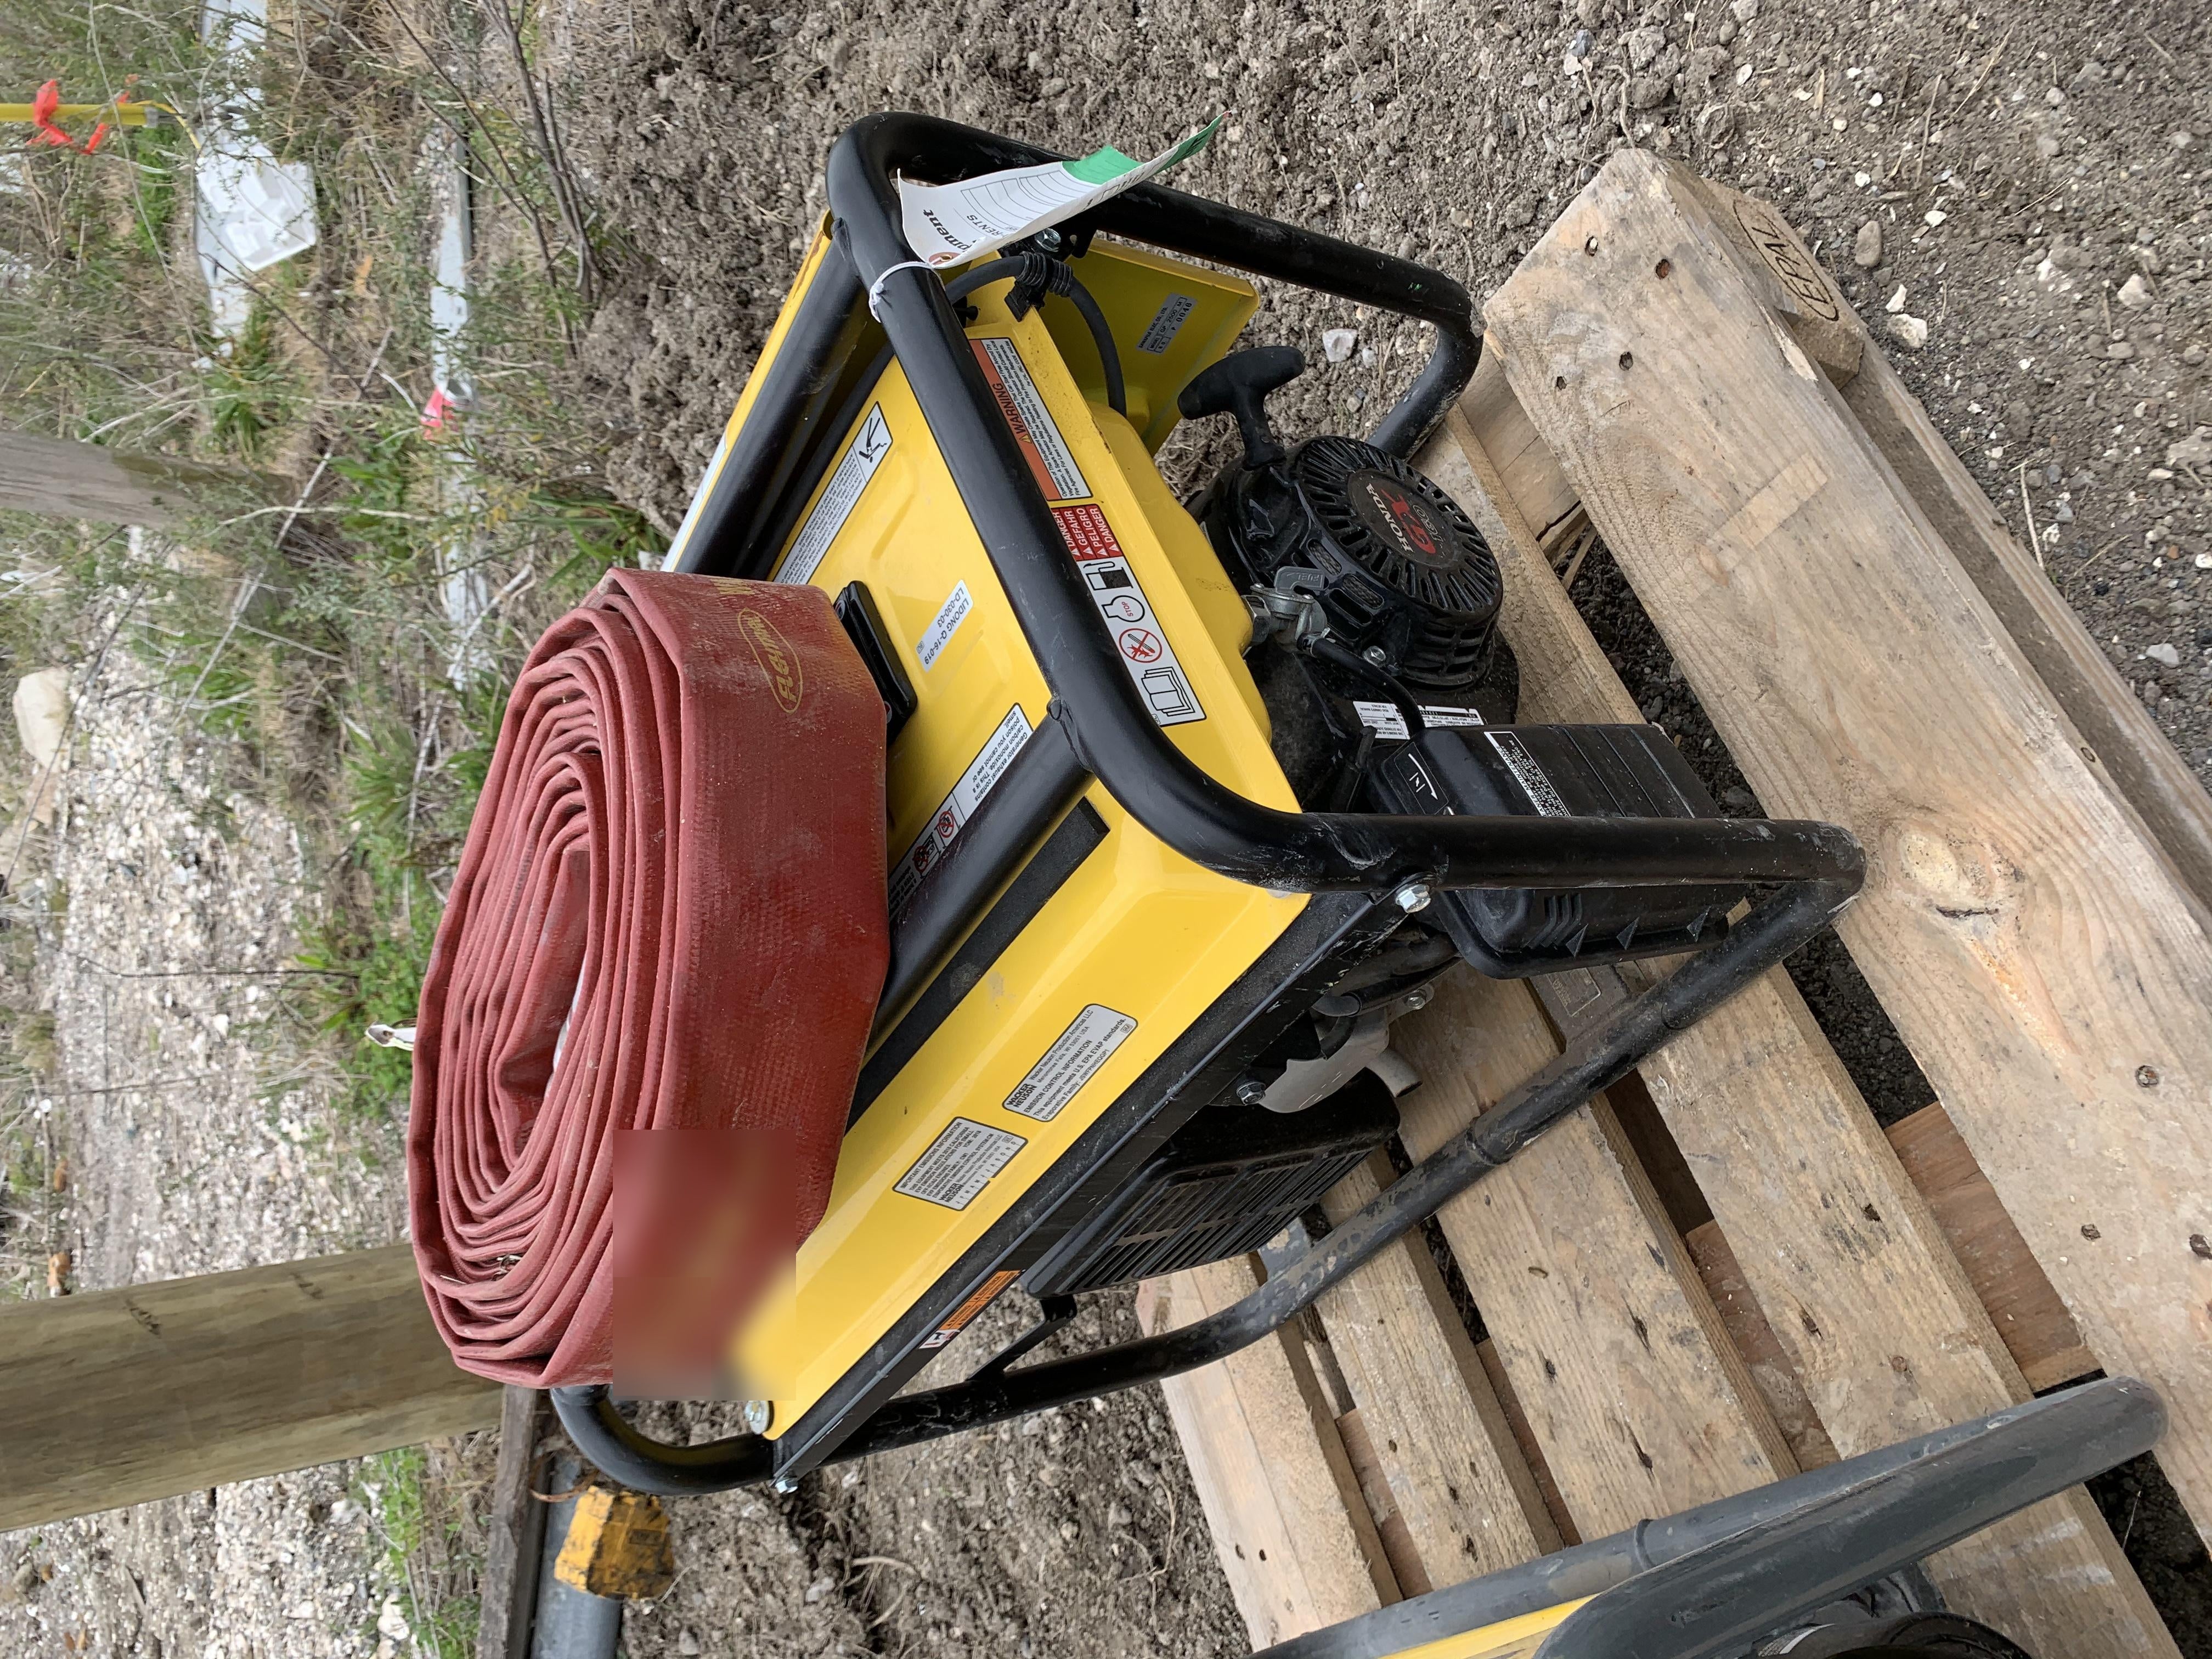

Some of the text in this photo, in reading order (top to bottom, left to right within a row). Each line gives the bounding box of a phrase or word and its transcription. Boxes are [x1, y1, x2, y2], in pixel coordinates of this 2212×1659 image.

[967, 215, 1006, 238] -RENTS
[1752, 223, 1829, 304] EPAL
[990, 341, 998, 350] Local
[988, 351, 999, 364] Around
[995, 351, 1006, 365] Contact
[996, 365, 1004, 374] Fires
[1001, 375, 1009, 383] Start
[1003, 366, 1014, 379] Should
[1010, 380, 1023, 396] Operator
[1012, 370, 1026, 390] Prevention
[991, 382, 1026, 433] WARNING
[1015, 402, 1026, 415] Sparks
[1029, 403, 1042, 419] Relating
[1022, 416, 1033, 429] Create
[1038, 420, 1054, 443] Regulations
[1030, 430, 1039, 438] May
[1036, 430, 1045, 439] May
[1034, 439, 1049, 461] Equipment
[1041, 439, 1053, 455] Arrestor
[1053, 449, 1062, 459] Laws
[1049, 456, 1060, 468] Spark
[1053, 476, 1068, 496] Operation
[1059, 473, 1074, 496] Vegetation.
[1063, 468, 1077, 487] Agencies
[1075, 507, 1103, 546] PELIGRO
[1089, 508, 1114, 542] DANGER
[1366, 483, 1413, 552] HONDA
[1051, 512, 1076, 546] DANGER
[1063, 510, 1088, 545] GEFAHR
[1296, 572, 1319, 581] FUEL
[936, 587, 964, 628] LD-030-03
[1121, 601, 1133, 617] STOP
[923, 597, 969, 665] LIDONG Q-16-019
[1003, 710, 1017, 729] smell.
[1005, 716, 1020, 738] poison
[996, 735, 1006, 748] you
[1008, 724, 1024, 745] carbon
[984, 746, 998, 768] cannot
[988, 742, 1009, 772] monoxide.
[1511, 749, 1529, 769] SOLVENT
[1522, 759, 1536, 772] CLEAN
[974, 731, 1028, 803] Generator exhaust contains
[1495, 746, 1530, 790] MAINTENANCE
[1514, 763, 1527, 778] HOURS
[972, 774, 977, 783] or
[975, 781, 980, 789] is
[979, 770, 989, 785] This
[1533, 785, 1546, 800] DUSTY
[1547, 788, 1556, 797] OUT
[1547, 794, 1558, 806] THEN
[1544, 803, 1556, 815] NDER
[1006, 1082, 1030, 1106] WACKER
[1052, 1034, 1073, 1054] Production
[1068, 1018, 1087, 1036] Americas
[1082, 1009, 1094, 1019] LLC
[1013, 1084, 1037, 1108] NEUSON
[1079, 1025, 1090, 1035] USA
[1033, 1017, 1126, 1116] This equipment meets U.S. EPA EVAP standards.
[1024, 1039, 1093, 1113] EMISSION CONTROL INFORMATION
[1041, 1080, 1082, 1120] Evaporative Family:
[899, 1121, 963, 1189] IMPORTANT EMISSIONS INFORMATION
[915, 1165, 935, 1183] EQUIPMENT
[932, 1154, 945, 1165] MEETS
[949, 1126, 969, 1147] CALIFORNIA
[920, 1171, 937, 1186] EMISSION
[934, 1148, 957, 1171] REGULATIONS
[960, 1130, 974, 1142] SMALL
[932, 1150, 978, 1198] EVAPORATIVE EMISSION CONTROL
[932, 1172, 950, 1189] EMISSIONS
[938, 1182, 959, 1201] WACKER
[944, 1184, 964, 1203] NEUSON
